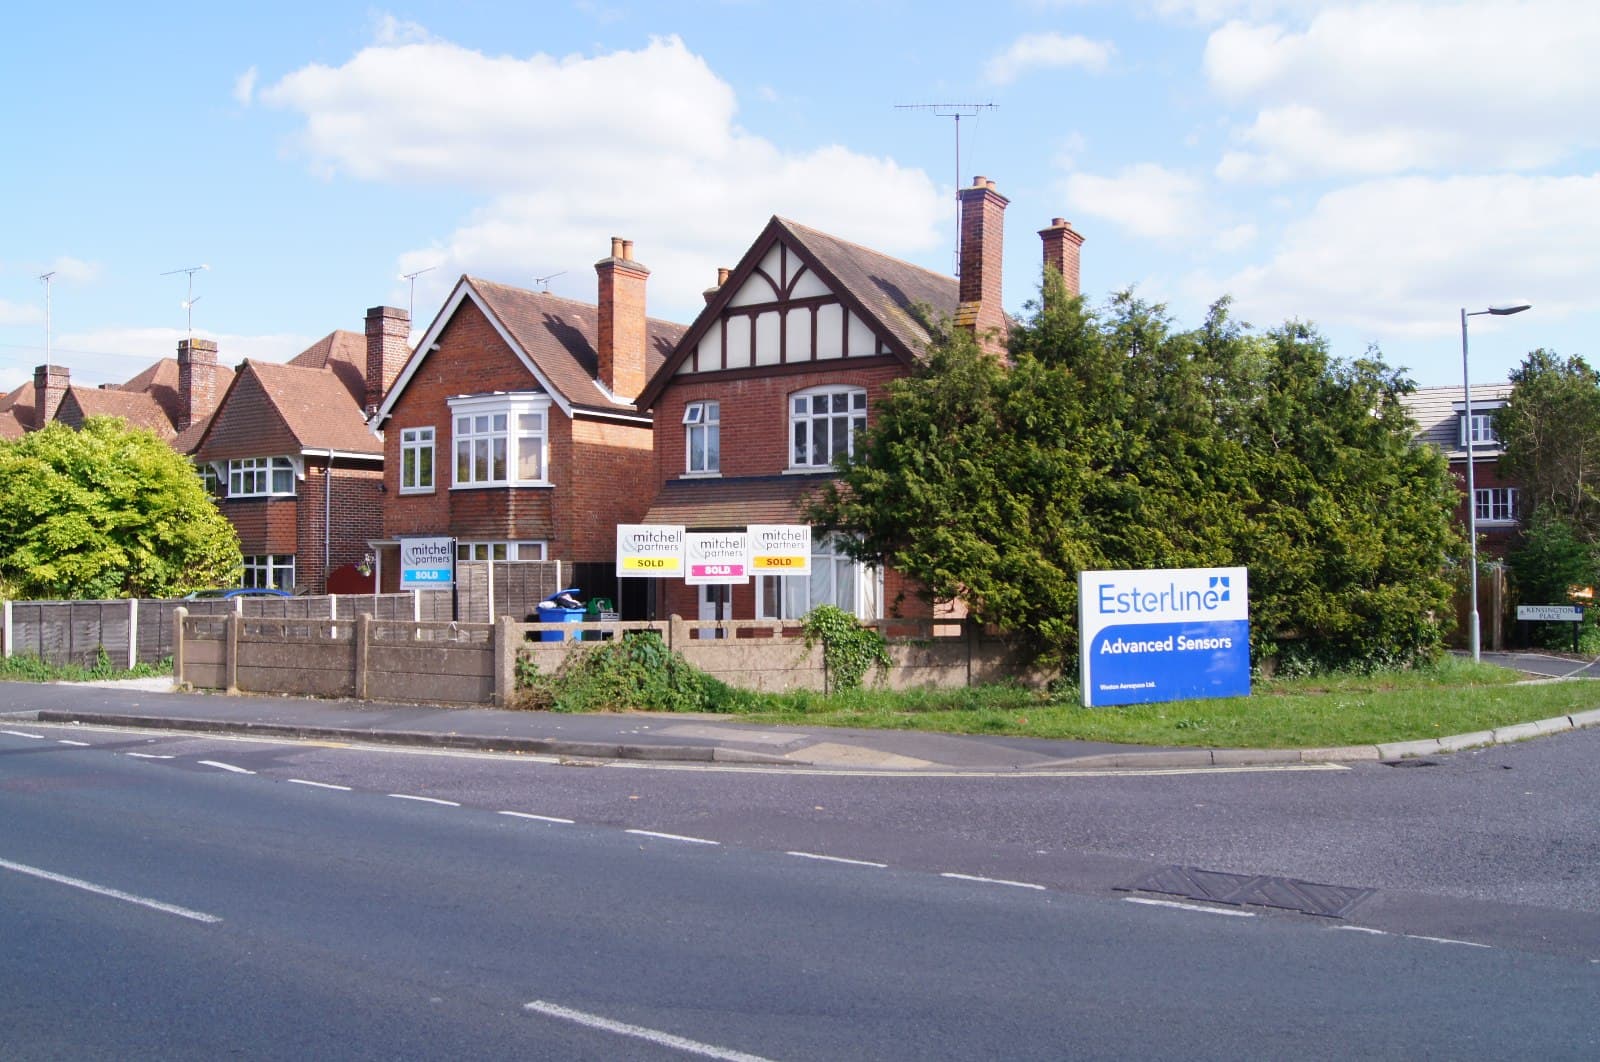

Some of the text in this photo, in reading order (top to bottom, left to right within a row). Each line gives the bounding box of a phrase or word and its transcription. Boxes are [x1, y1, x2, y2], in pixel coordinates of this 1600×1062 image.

[634, 530, 682, 542] mitchell
[762, 528, 808, 541] mitchell
[637, 543, 679, 553] partners
[700, 537, 746, 549] mitchell
[766, 541, 804, 551] partners
[412, 542, 453, 556] mitchell
[704, 550, 743, 560] partners
[415, 556, 450, 566] partners
[637, 559, 664, 568] SOLD
[766, 558, 792, 566] SOLD
[415, 570, 439, 580] SOLD
[704, 566, 731, 575] SOLD
[1098, 582, 1219, 614] Esterline
[1100, 635, 1232, 654] Advanced Sensors
